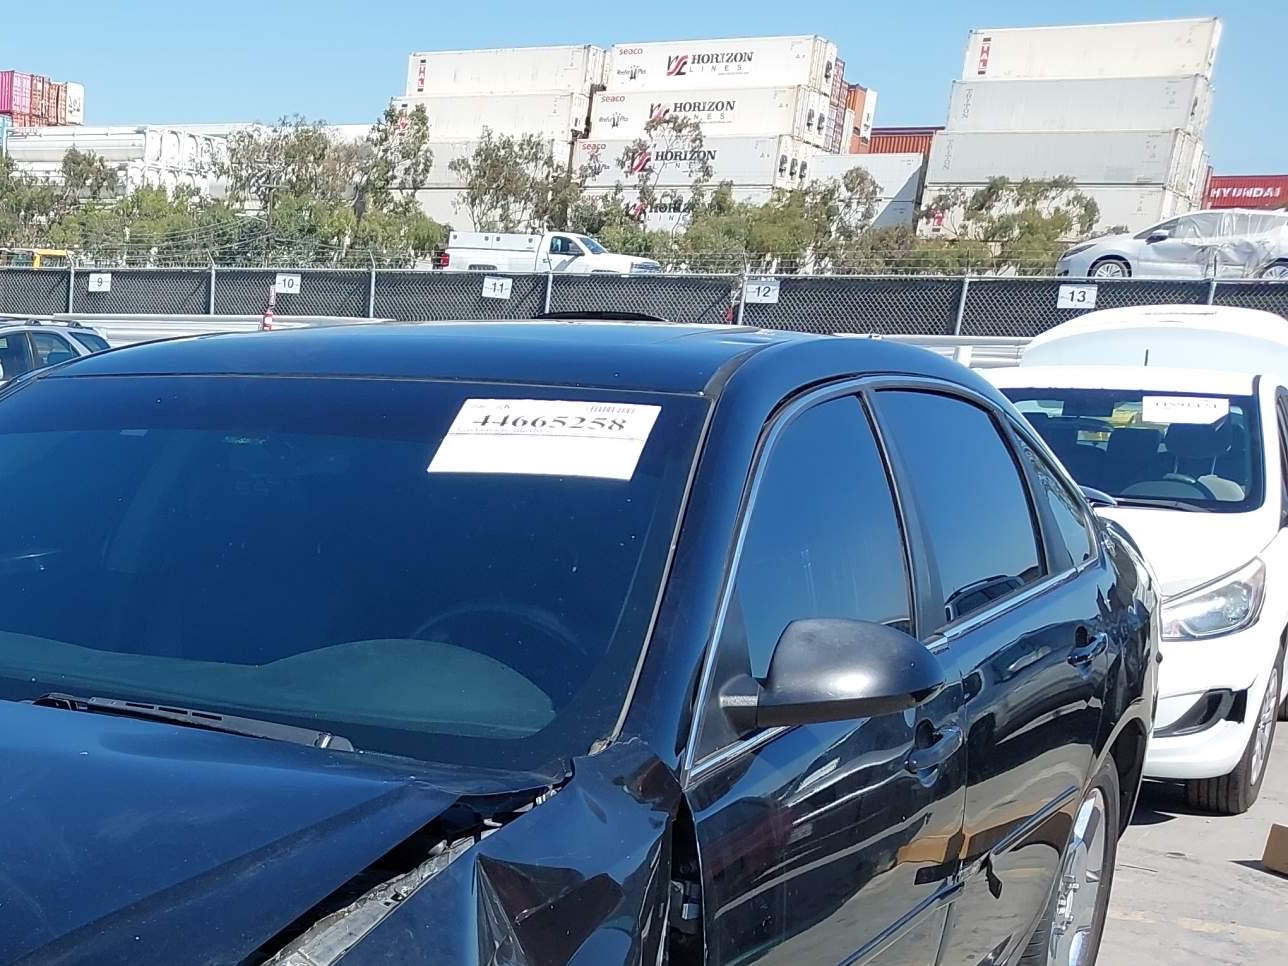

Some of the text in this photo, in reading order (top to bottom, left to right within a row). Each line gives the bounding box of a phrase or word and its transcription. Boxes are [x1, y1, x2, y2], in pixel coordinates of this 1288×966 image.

[618, 47, 643, 55] seaco
[691, 51, 754, 65] HORIZON
[690, 64, 743, 73] LINES
[600, 95, 626, 103] seaco
[673, 100, 736, 113] HORIZON
[654, 150, 717, 161] HORIZON
[1210, 187, 1281, 198] HYUNDAI
[97, 277, 103, 287] 9
[283, 278, 294, 289] 10
[492, 281, 504, 293] 11
[756, 286, 772, 298] 12
[1069, 290, 1087, 302] 13
[472, 409, 627, 431] 44665258
